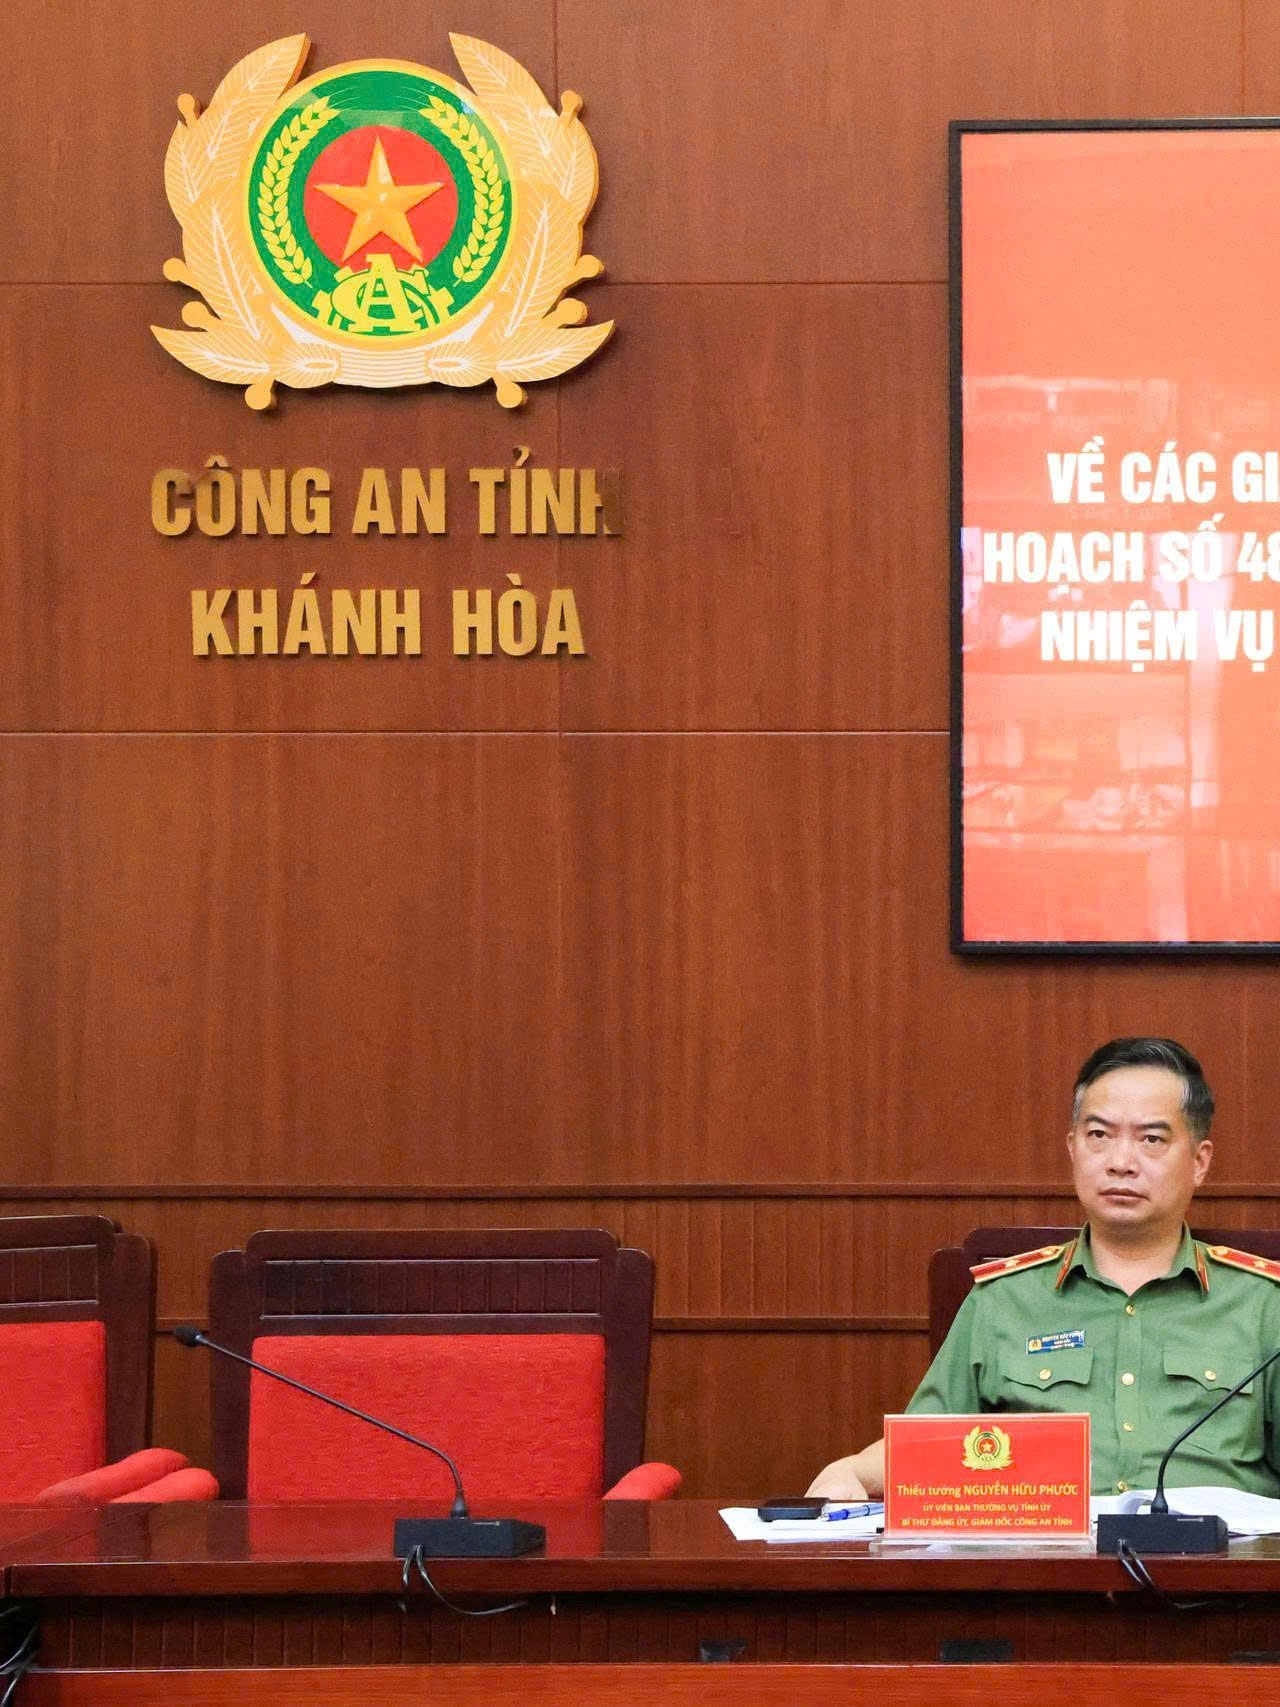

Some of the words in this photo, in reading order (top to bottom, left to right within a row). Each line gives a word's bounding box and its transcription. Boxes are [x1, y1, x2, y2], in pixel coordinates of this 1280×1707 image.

[152, 455, 330, 535] CÔNG
[352, 467, 446, 535] AN
[1047, 436, 1105, 503] VỀ
[1121, 441, 1216, 503] CÁC
[983, 531, 1144, 594] HOẠCH
[1158, 513, 1224, 583] SỐ
[190, 572, 421, 656] KHÁNH
[452, 572, 586, 655] HÒA
[1041, 597, 1201, 672] NHIỆM
[1212, 605, 1274, 672] VỤ
[896, 1483, 926, 1496] Thiếu
[1011, 1482, 1037, 1496] HỮU
[955, 1502, 970, 1512] BAN
[1039, 1516, 1051, 1526] AN
